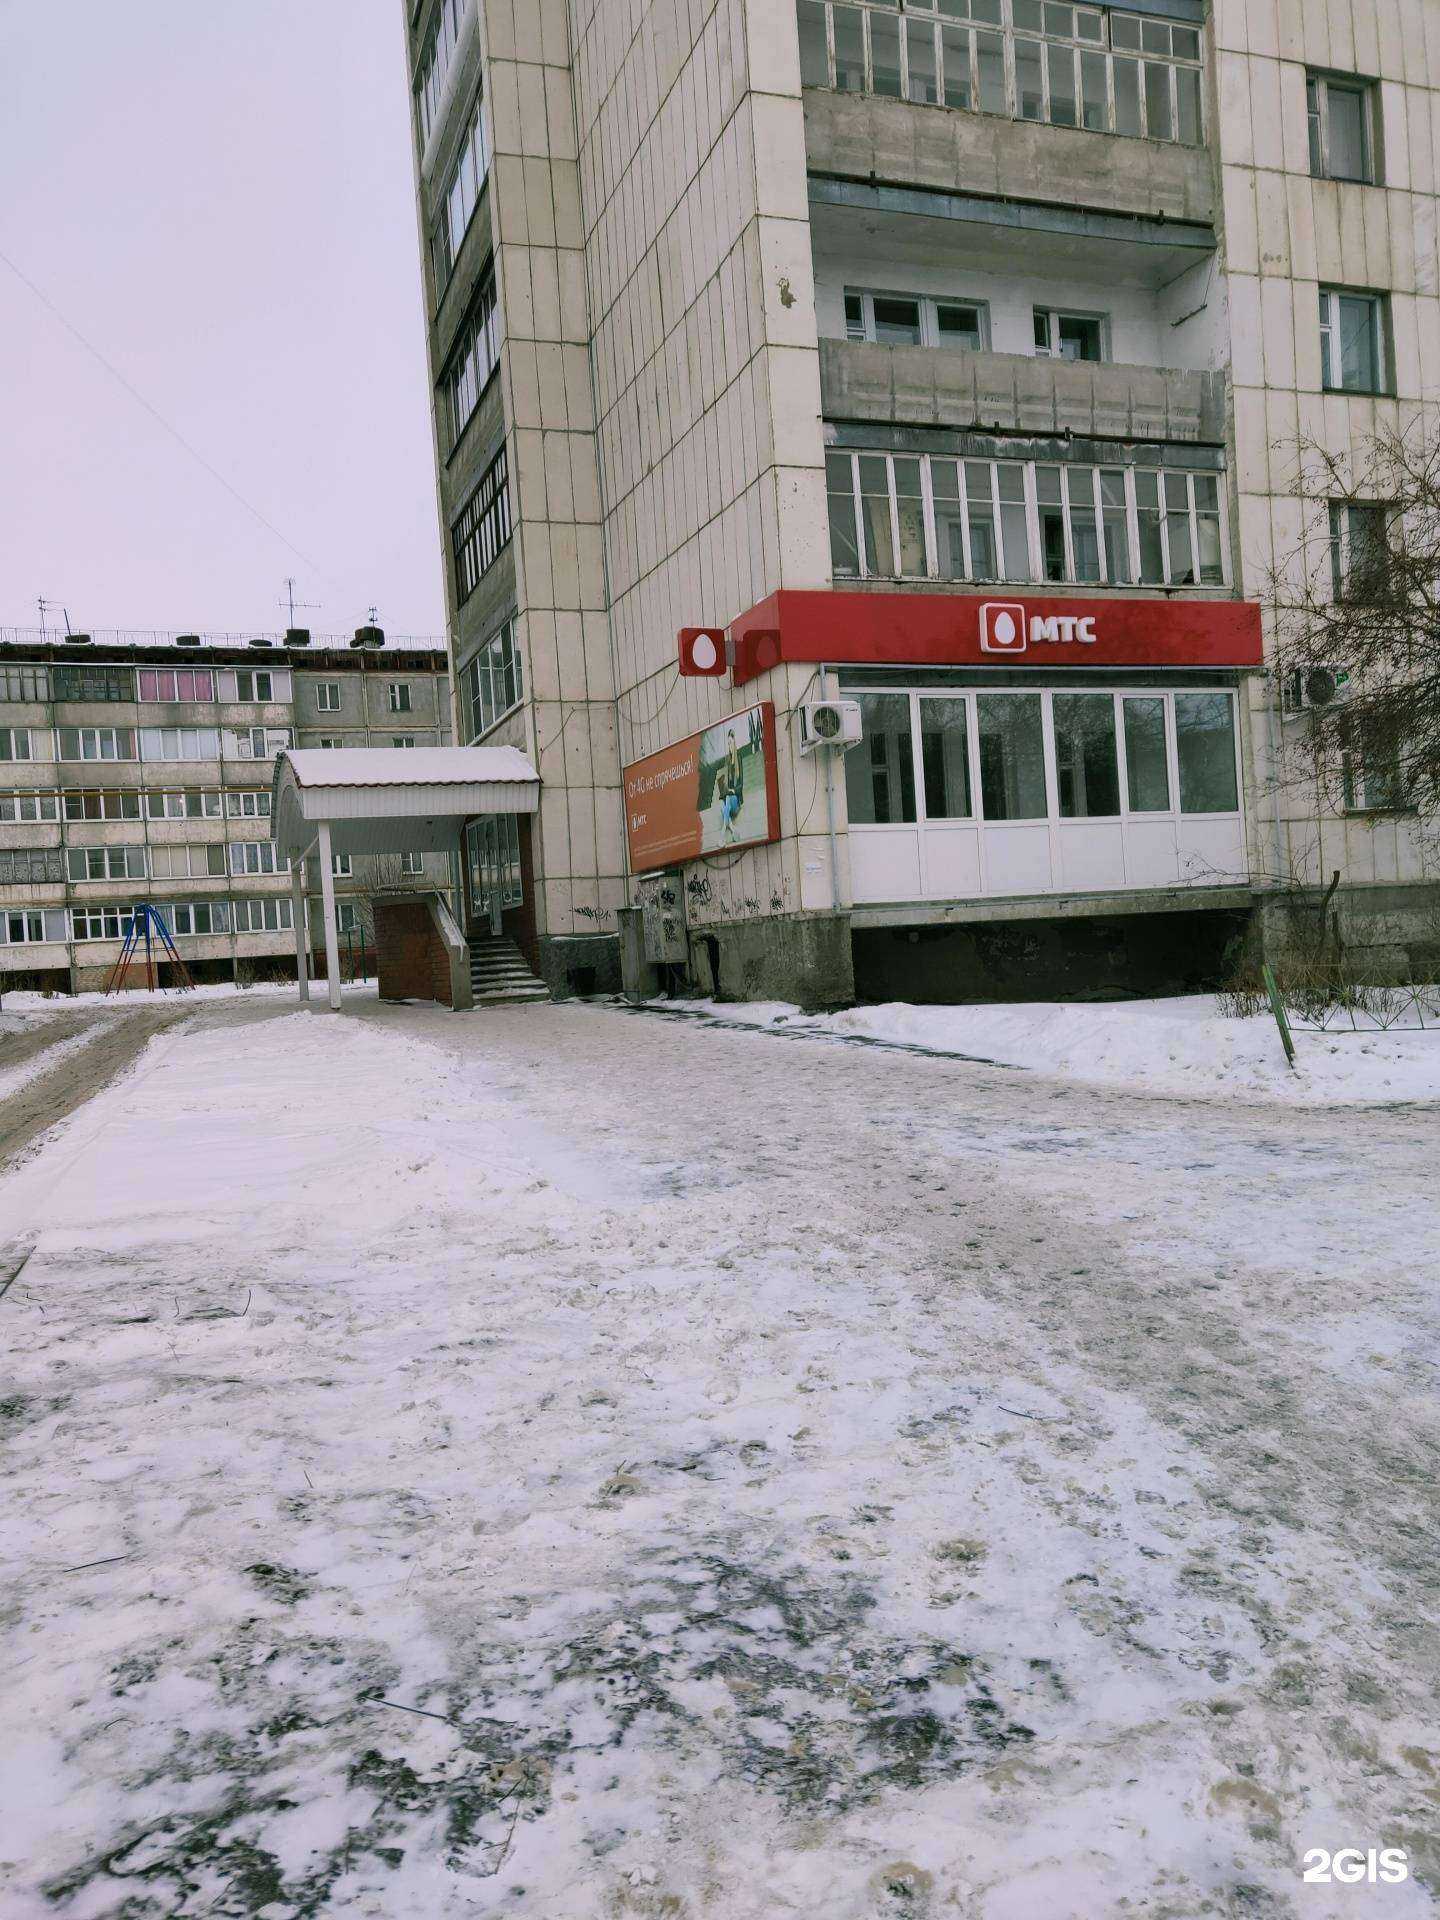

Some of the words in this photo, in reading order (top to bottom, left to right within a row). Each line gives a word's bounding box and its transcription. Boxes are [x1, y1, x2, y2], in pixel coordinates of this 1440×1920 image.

[1029, 616, 1097, 643] МТС
[628, 782, 636, 798] От
[645, 776, 654, 791] не
[654, 752, 694, 790] спрячешься!
